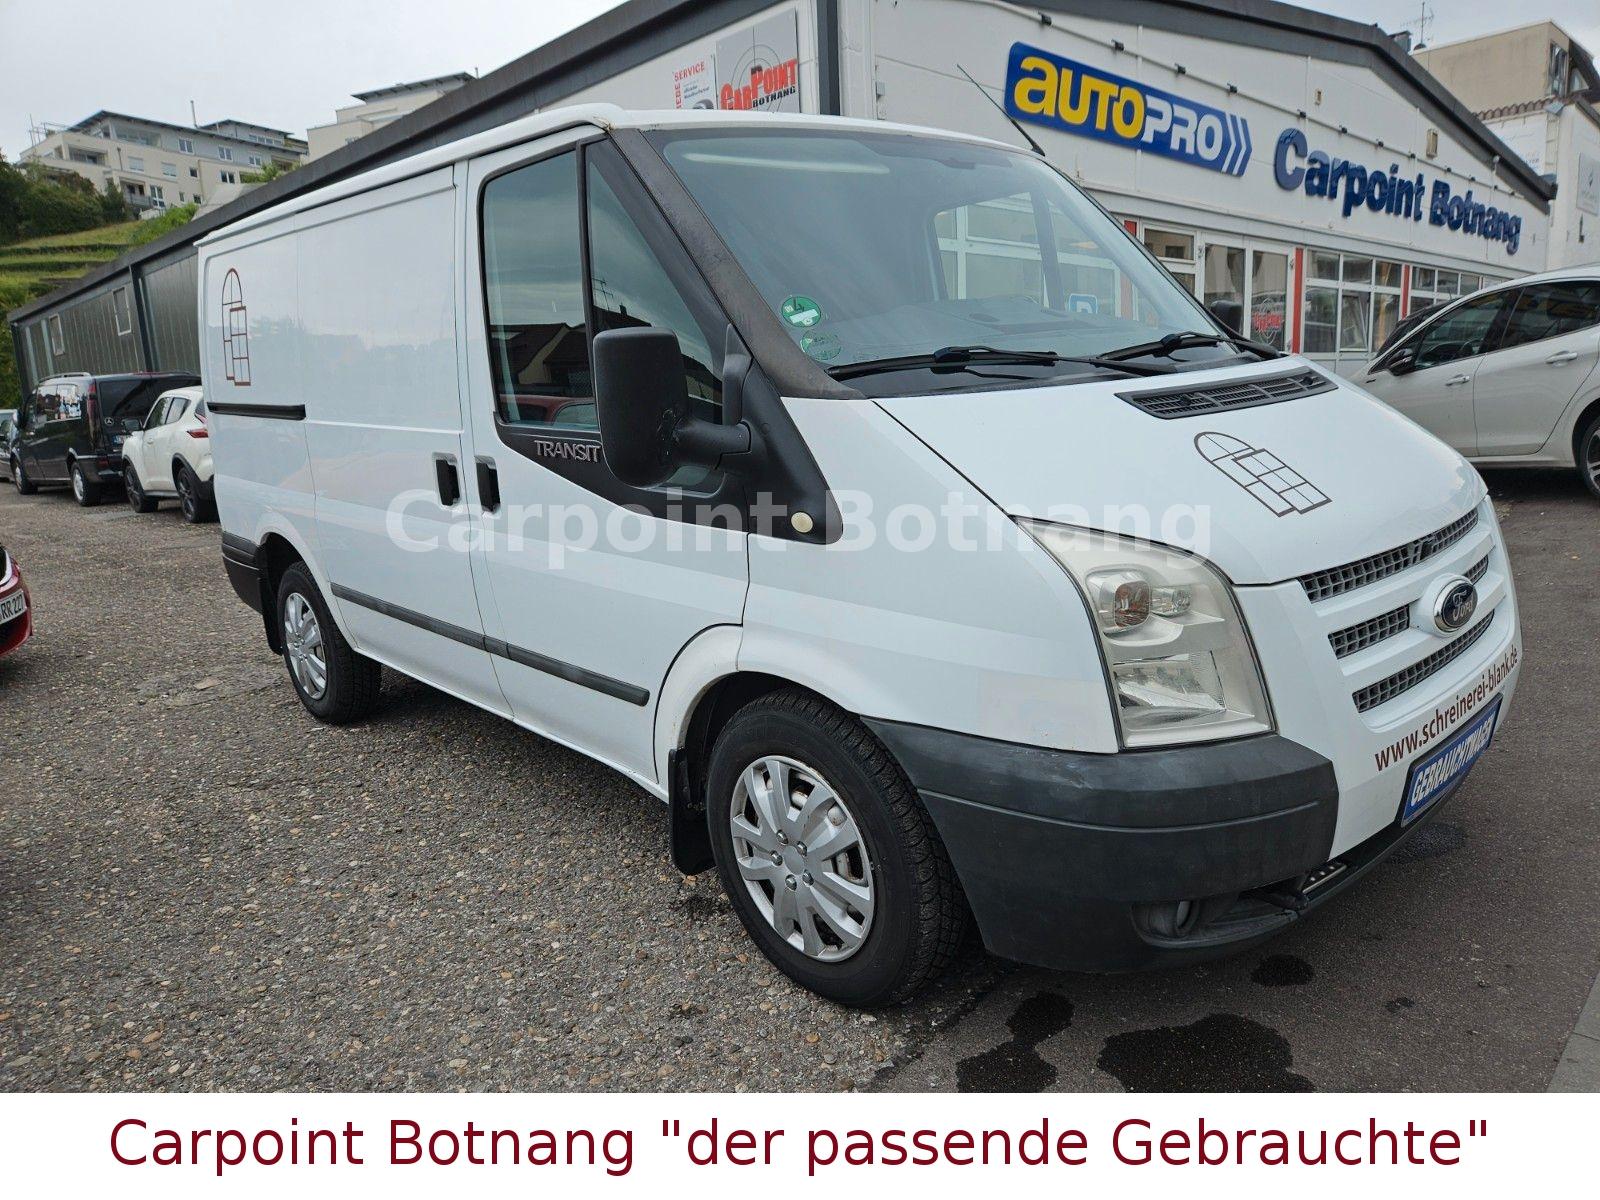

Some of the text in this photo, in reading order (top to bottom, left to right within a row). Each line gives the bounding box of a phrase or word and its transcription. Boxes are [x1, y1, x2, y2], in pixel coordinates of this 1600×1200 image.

[674, 61, 705, 81] SERVICE
[1273, 127, 1523, 255] Carpoint Botnang
[534, 440, 601, 462] TRANSIT
[1452, 589, 1473, 622] Ford
[1374, 645, 1518, 772] www.schreinerei-blank.de
